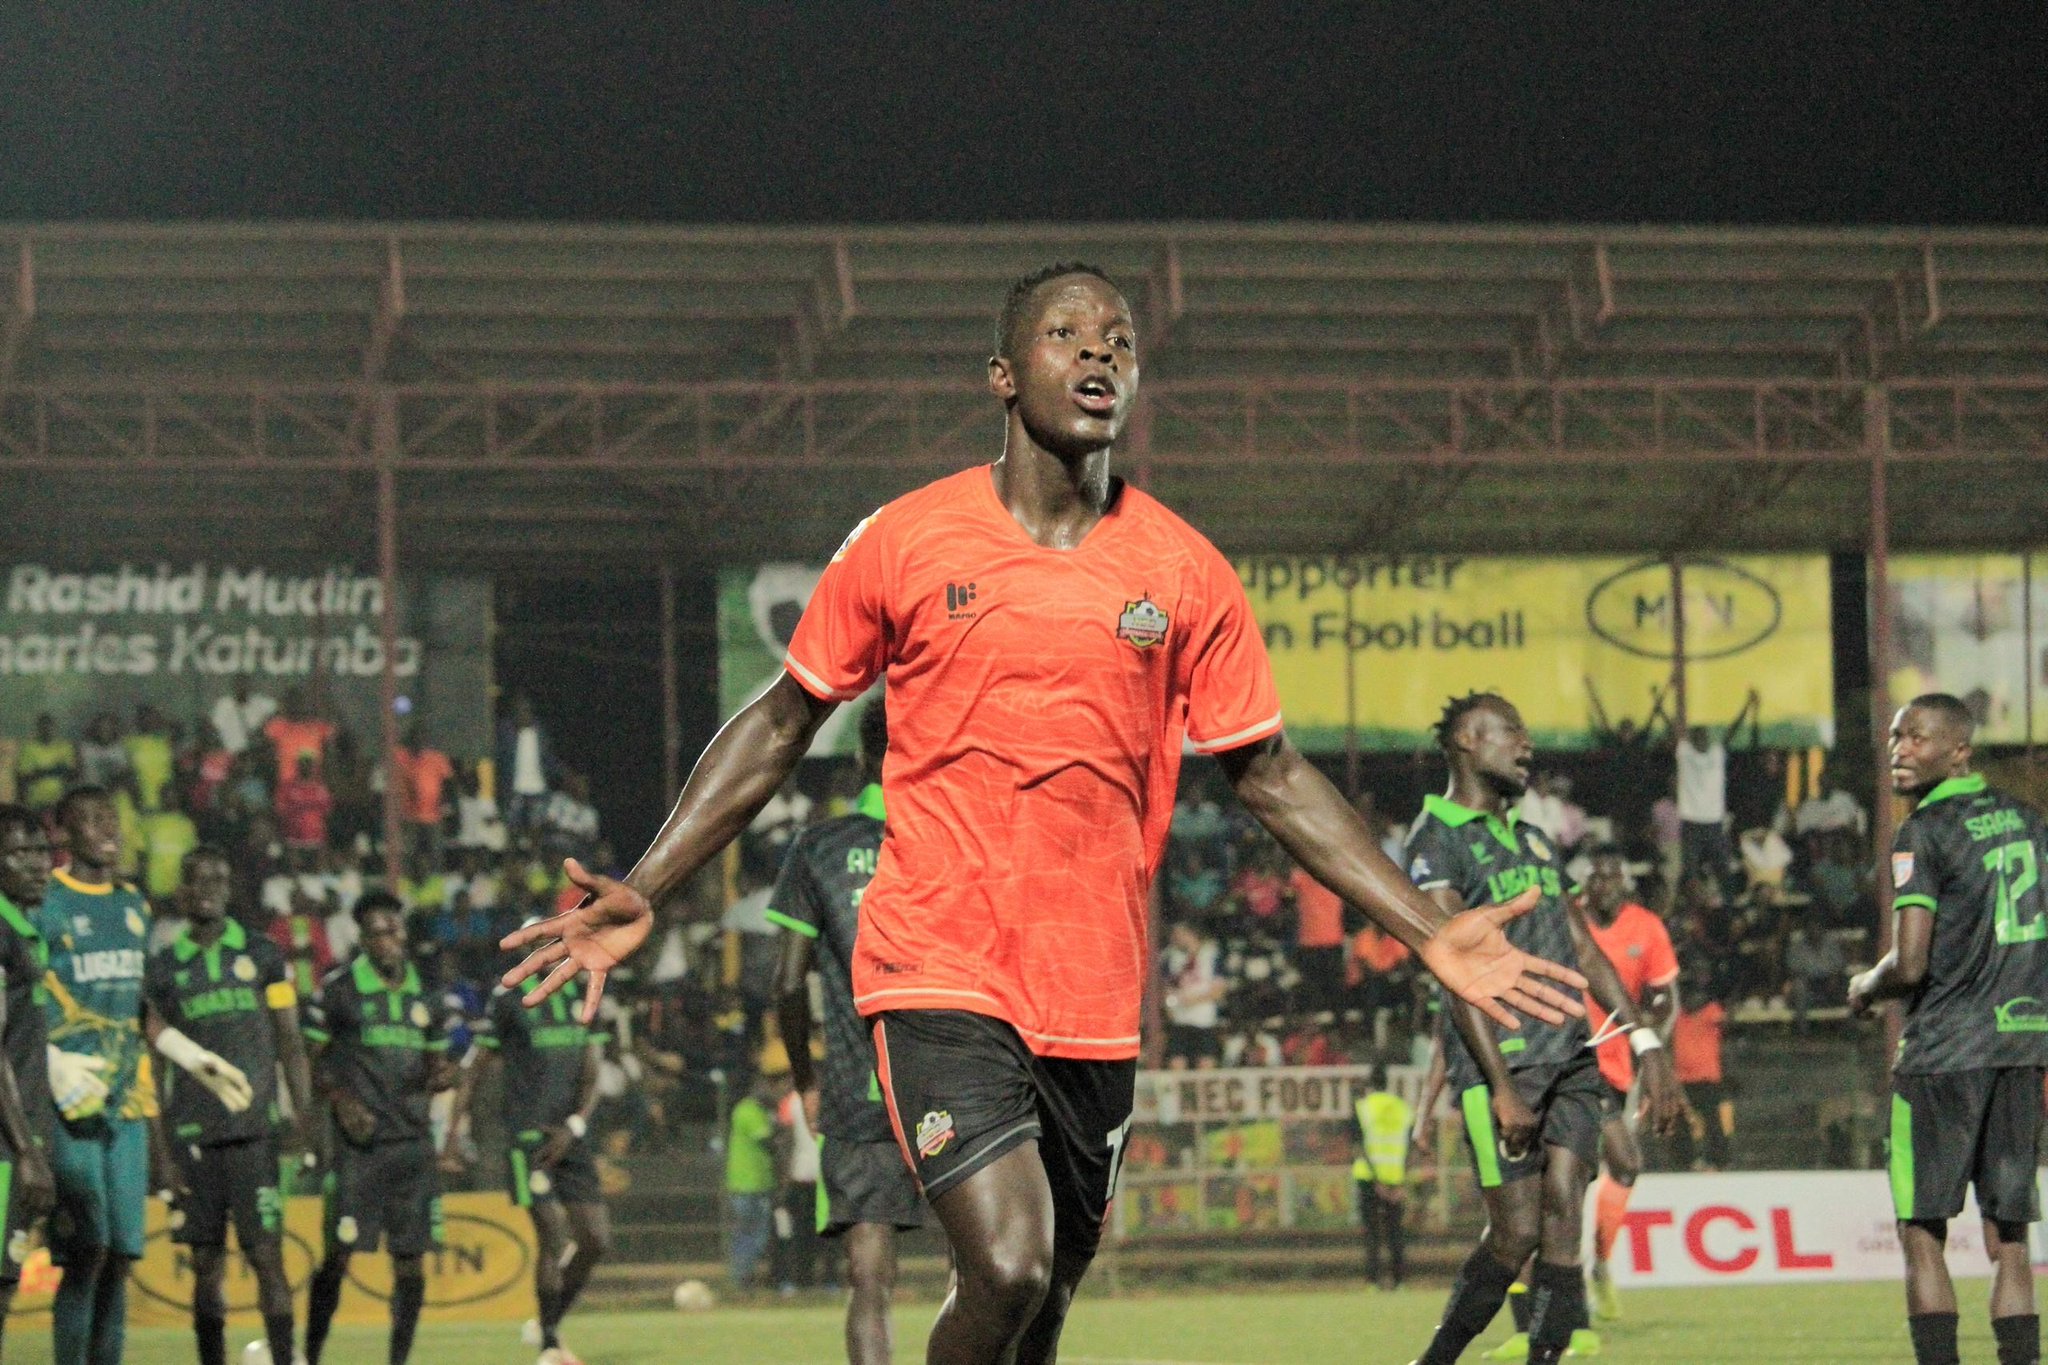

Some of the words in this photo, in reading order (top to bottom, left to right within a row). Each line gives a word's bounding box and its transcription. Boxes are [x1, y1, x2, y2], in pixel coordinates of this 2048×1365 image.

[9, 563, 206, 614] Rashid
[1634, 592, 1734, 630] MN
[1312, 610, 1524, 650] Football
[1623, 1206, 1834, 1275] TCL
